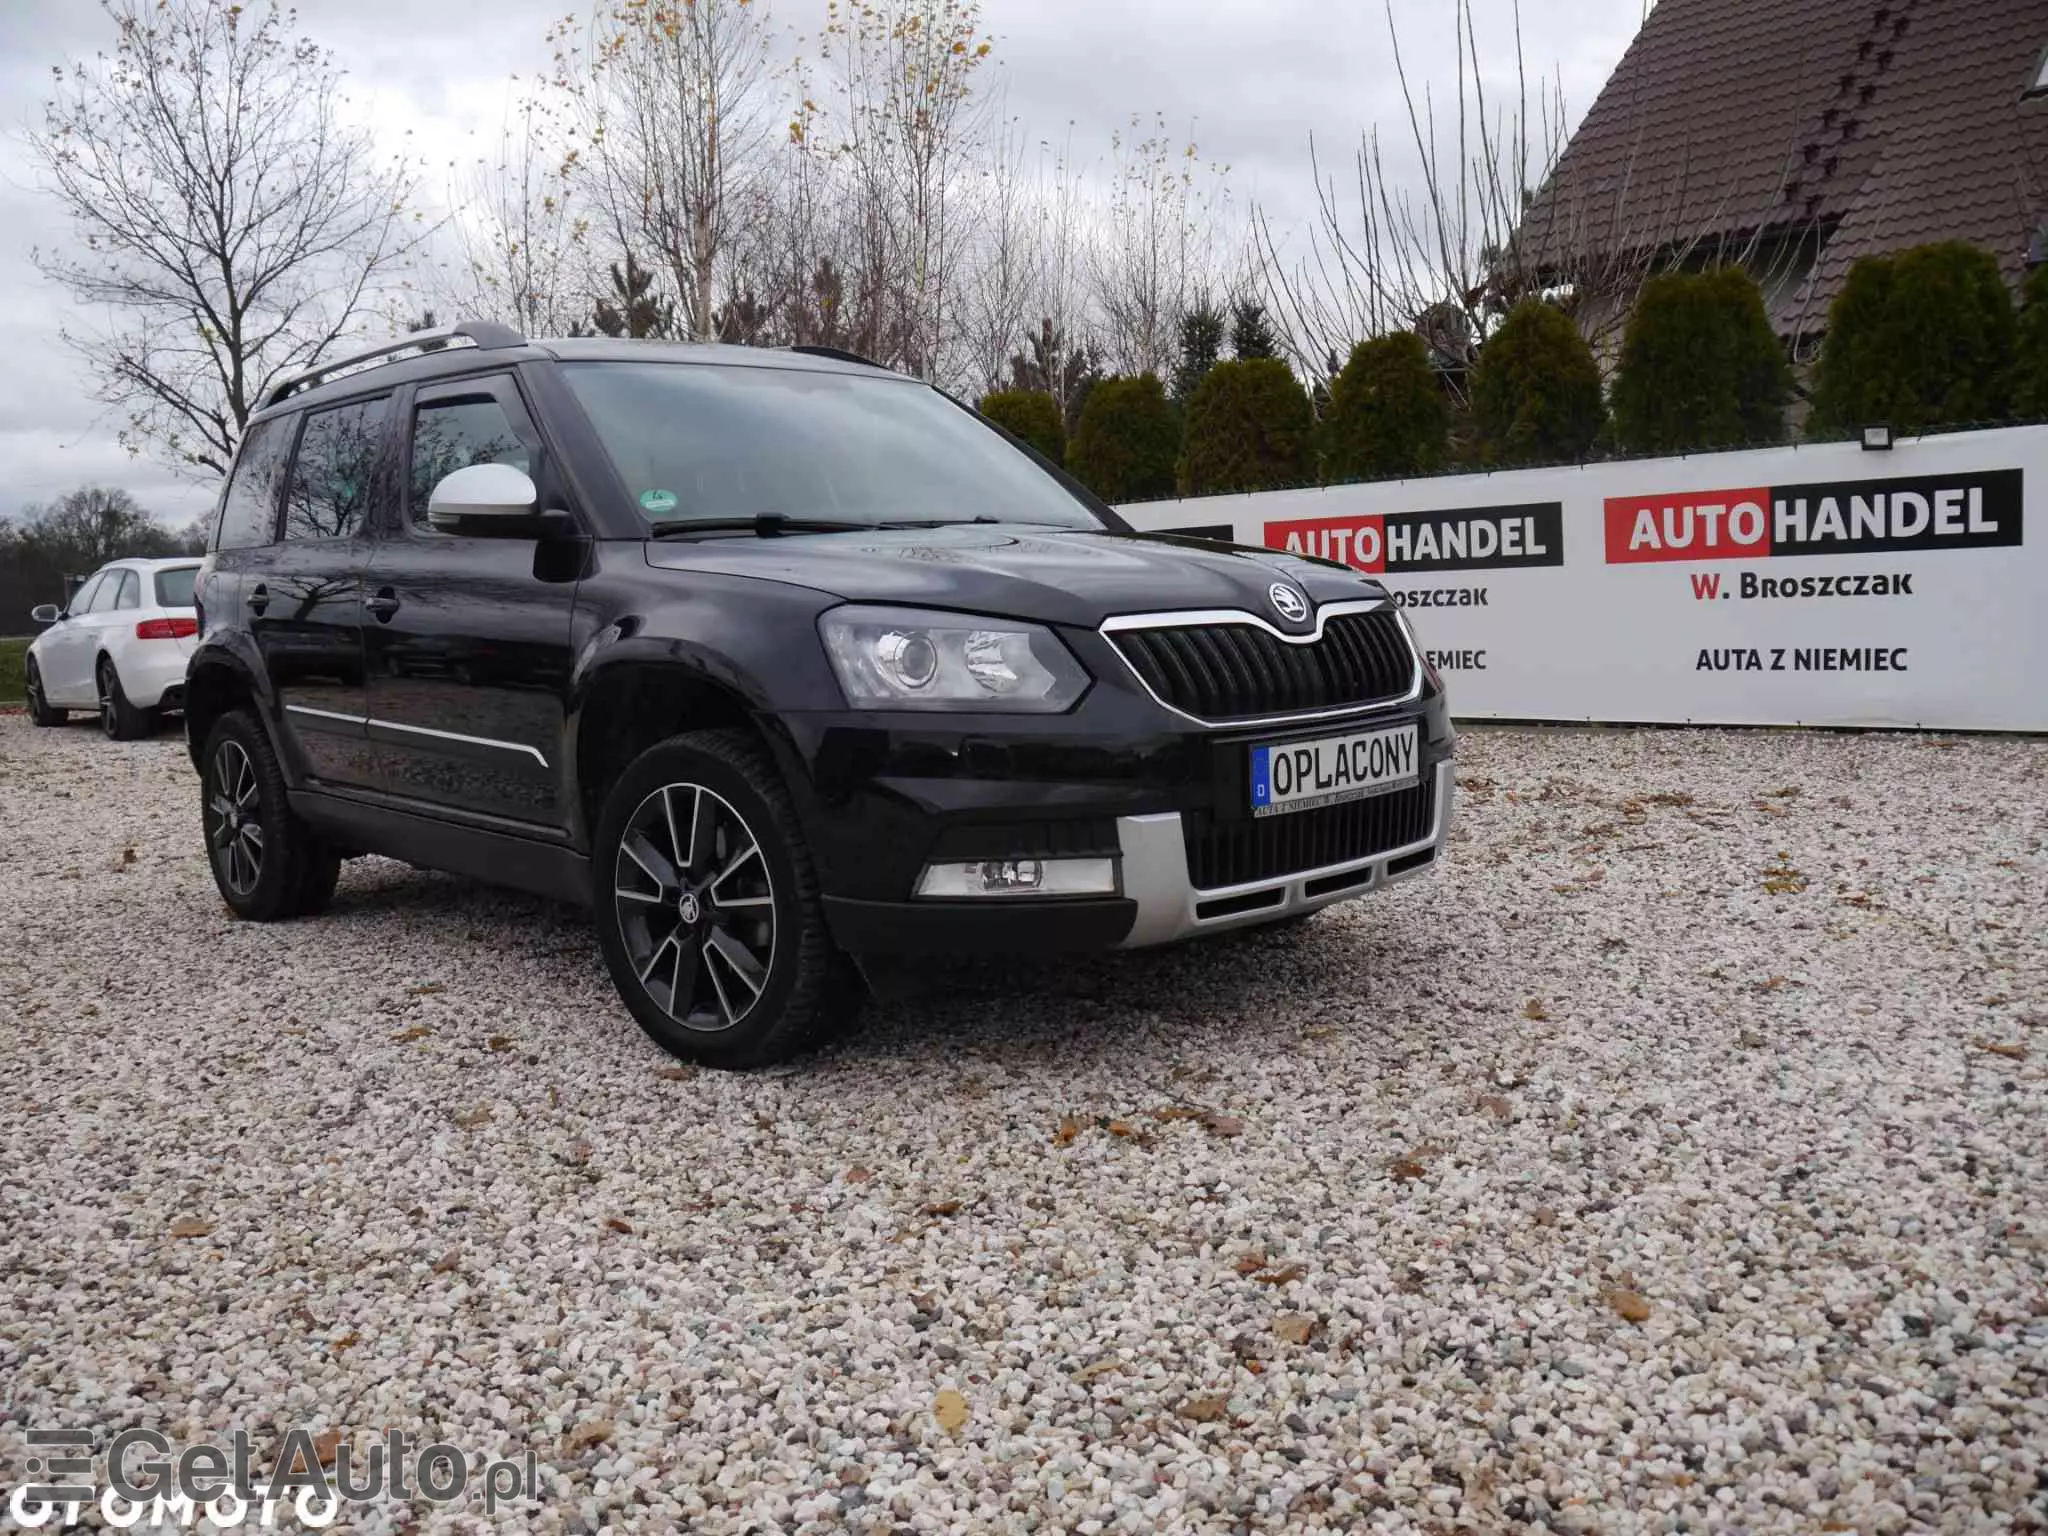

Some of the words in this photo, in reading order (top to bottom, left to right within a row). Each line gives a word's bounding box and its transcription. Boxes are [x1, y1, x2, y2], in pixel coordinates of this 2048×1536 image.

[1629, 487, 1999, 551] AUTOHANDEL
[1286, 517, 1547, 563] AUTOHANDEL
[1393, 588, 1490, 607] oszczak
[1690, 573, 1730, 600] W.
[1740, 572, 1914, 600] Broszczak
[1425, 650, 1487, 670] EMIEC
[1695, 648, 1763, 671] AUTA
[1770, 648, 1786, 671] Z
[1794, 647, 1908, 671] NIEMIEC
[1273, 731, 1414, 796] OPLACONY
